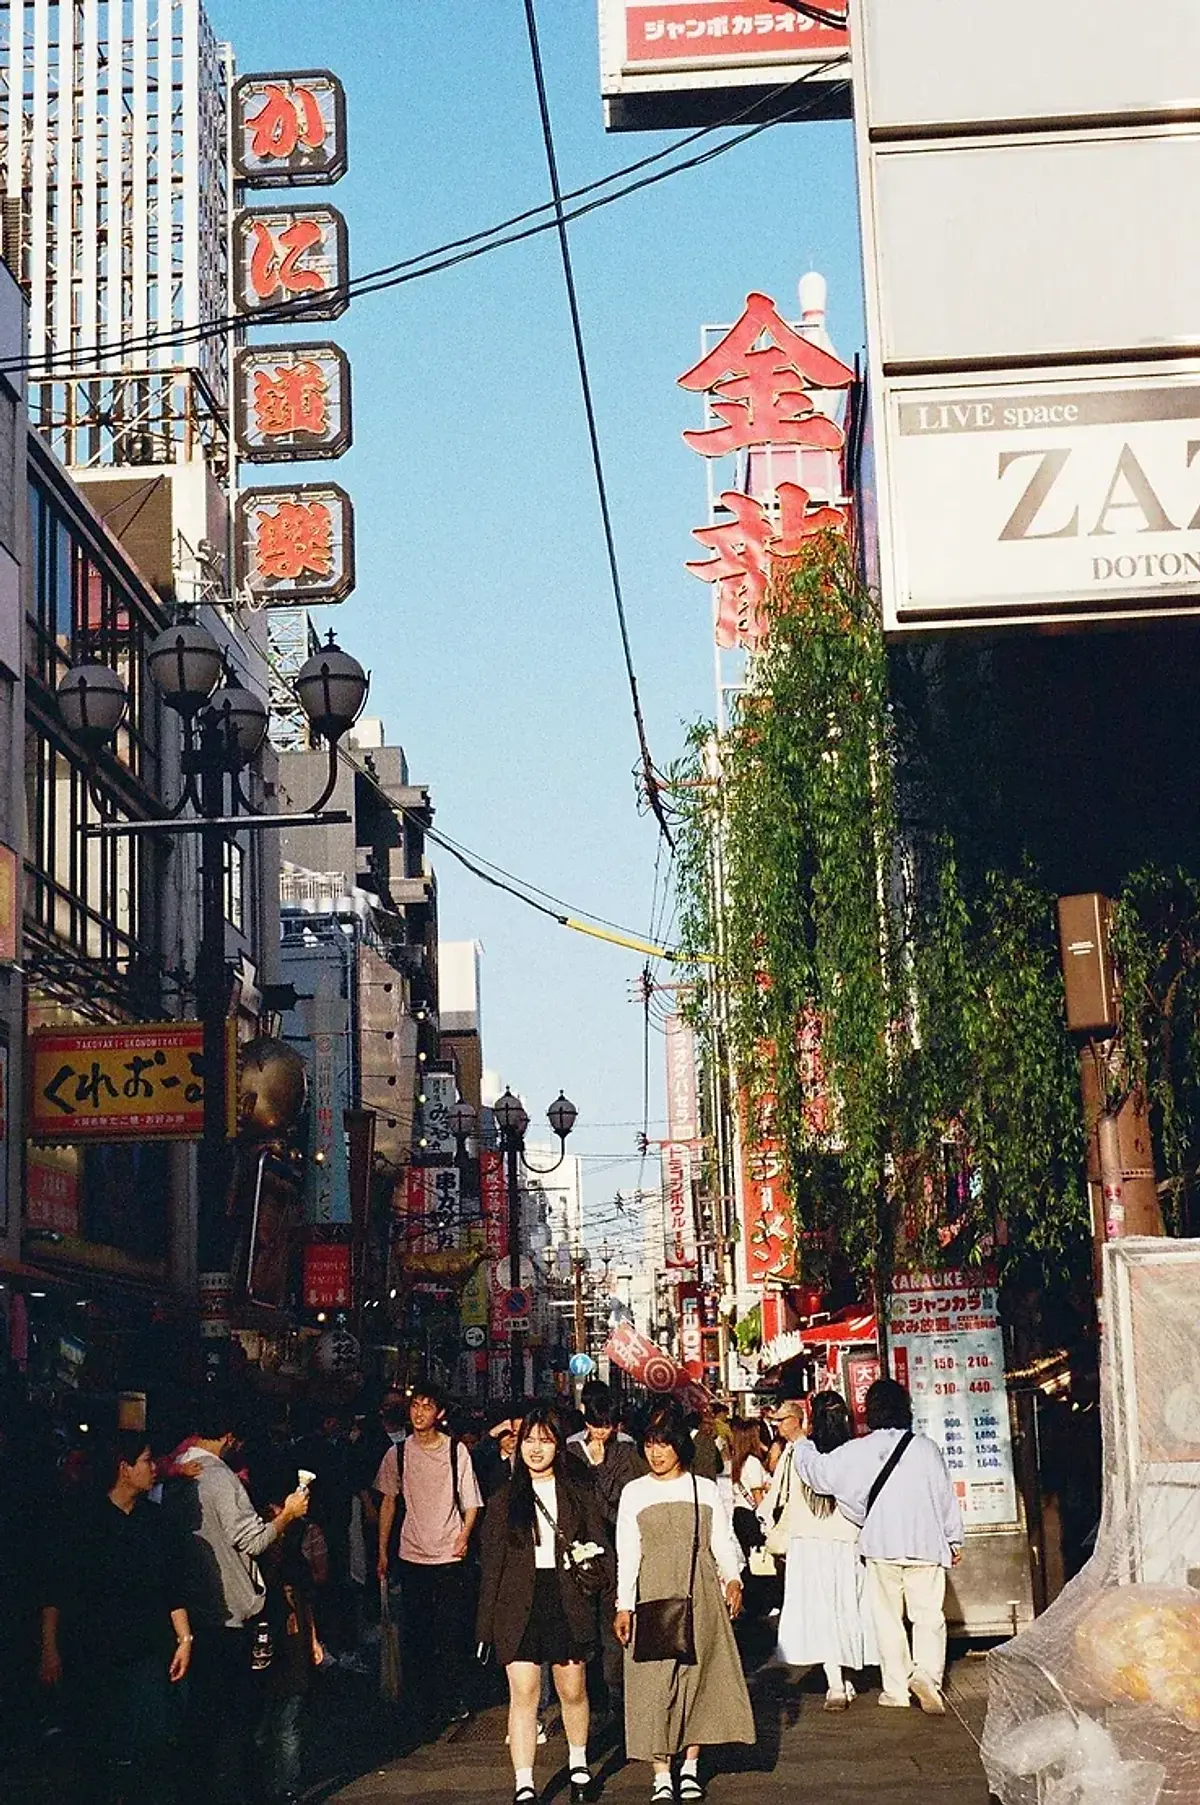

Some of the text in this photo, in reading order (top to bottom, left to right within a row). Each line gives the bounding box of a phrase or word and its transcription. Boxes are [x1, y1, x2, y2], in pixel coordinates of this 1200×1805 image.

[919, 403, 1079, 429] LIVE space
[997, 440, 1200, 541] ZA
